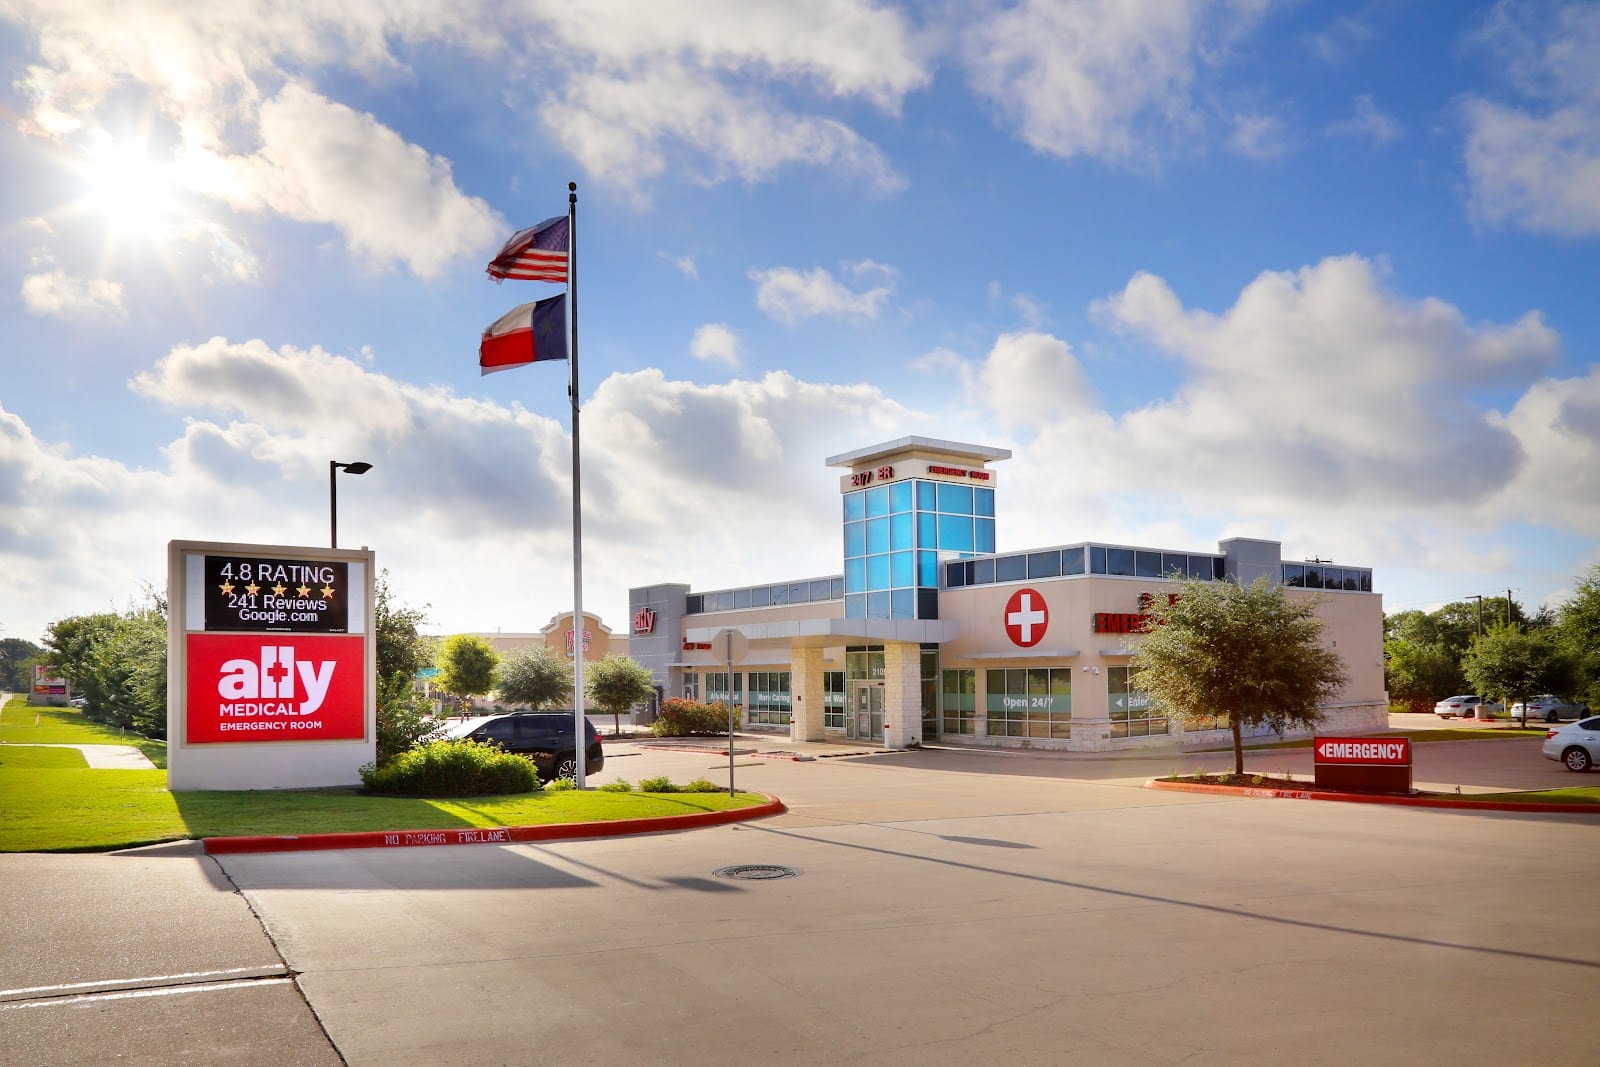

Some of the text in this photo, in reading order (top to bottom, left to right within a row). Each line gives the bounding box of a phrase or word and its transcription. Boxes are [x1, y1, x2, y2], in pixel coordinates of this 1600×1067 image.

[851, 465, 893, 486] 24/7 ER
[220, 562, 335, 584] 4.8 RATING
[227, 594, 328, 611] 241 Reviews
[238, 608, 319, 624] Google.com
[217, 645, 337, 716] ally
[219, 703, 298, 717] MEDICAL
[1003, 696, 1053, 709] Open 24/7
[220, 721, 322, 731] EMERGENCY ROOM
[1325, 743, 1404, 760] EMERGENCY
[384, 834, 399, 845] NO
[405, 832, 446, 845] PARKING
